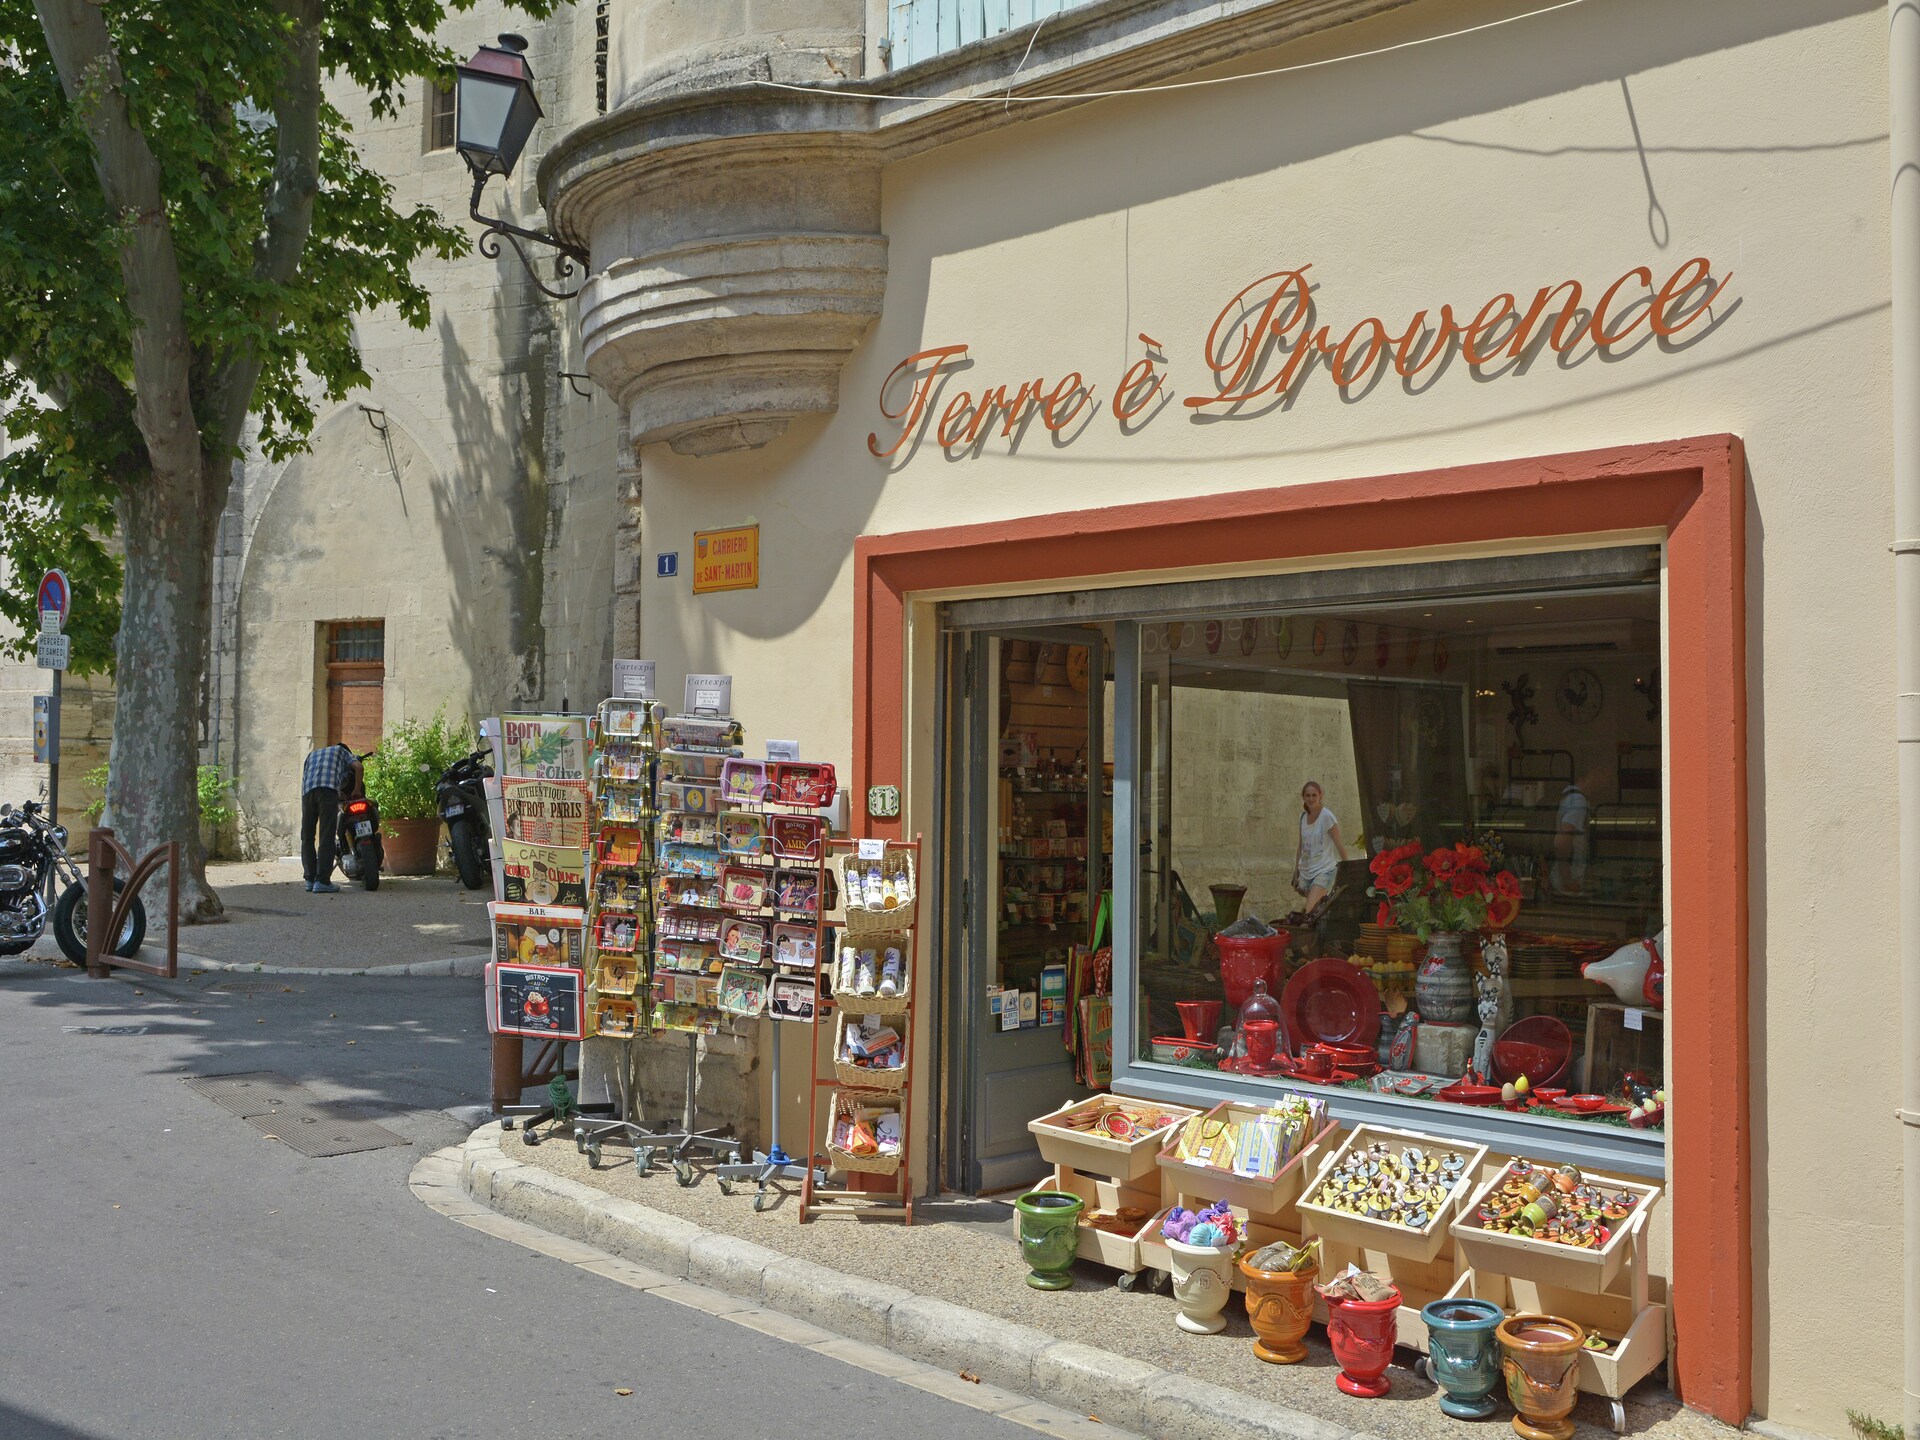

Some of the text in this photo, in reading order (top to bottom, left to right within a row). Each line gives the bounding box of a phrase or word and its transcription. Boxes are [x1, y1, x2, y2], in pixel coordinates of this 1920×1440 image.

[868, 257, 1733, 458] Terre è Provence
[712, 537, 748, 556] CARRIERO
[664, 556, 670, 573] 1
[704, 562, 753, 582] SANT-MARTIN
[39, 636, 67, 647] MERCREDI
[38, 646, 67, 658] ET SAMEDI
[614, 662, 655, 673] Cartexpo
[687, 678, 731, 687] Cartexpo
[505, 721, 542, 745] Born
[545, 765, 582, 779] Olive
[516, 785, 567, 801] AUTHENTIQUE
[506, 798, 545, 818] BISTROT
[550, 801, 582, 819] PARIS
[878, 792, 887, 811] 1
[785, 839, 807, 850] AMIS
[519, 849, 558, 864] CAFÉ
[529, 907, 546, 915] BAR
[525, 974, 550, 983] BISTROT
[1003, 1011, 1018, 1019] ALERTE
[1003, 1017, 1018, 1027] BLEUE
